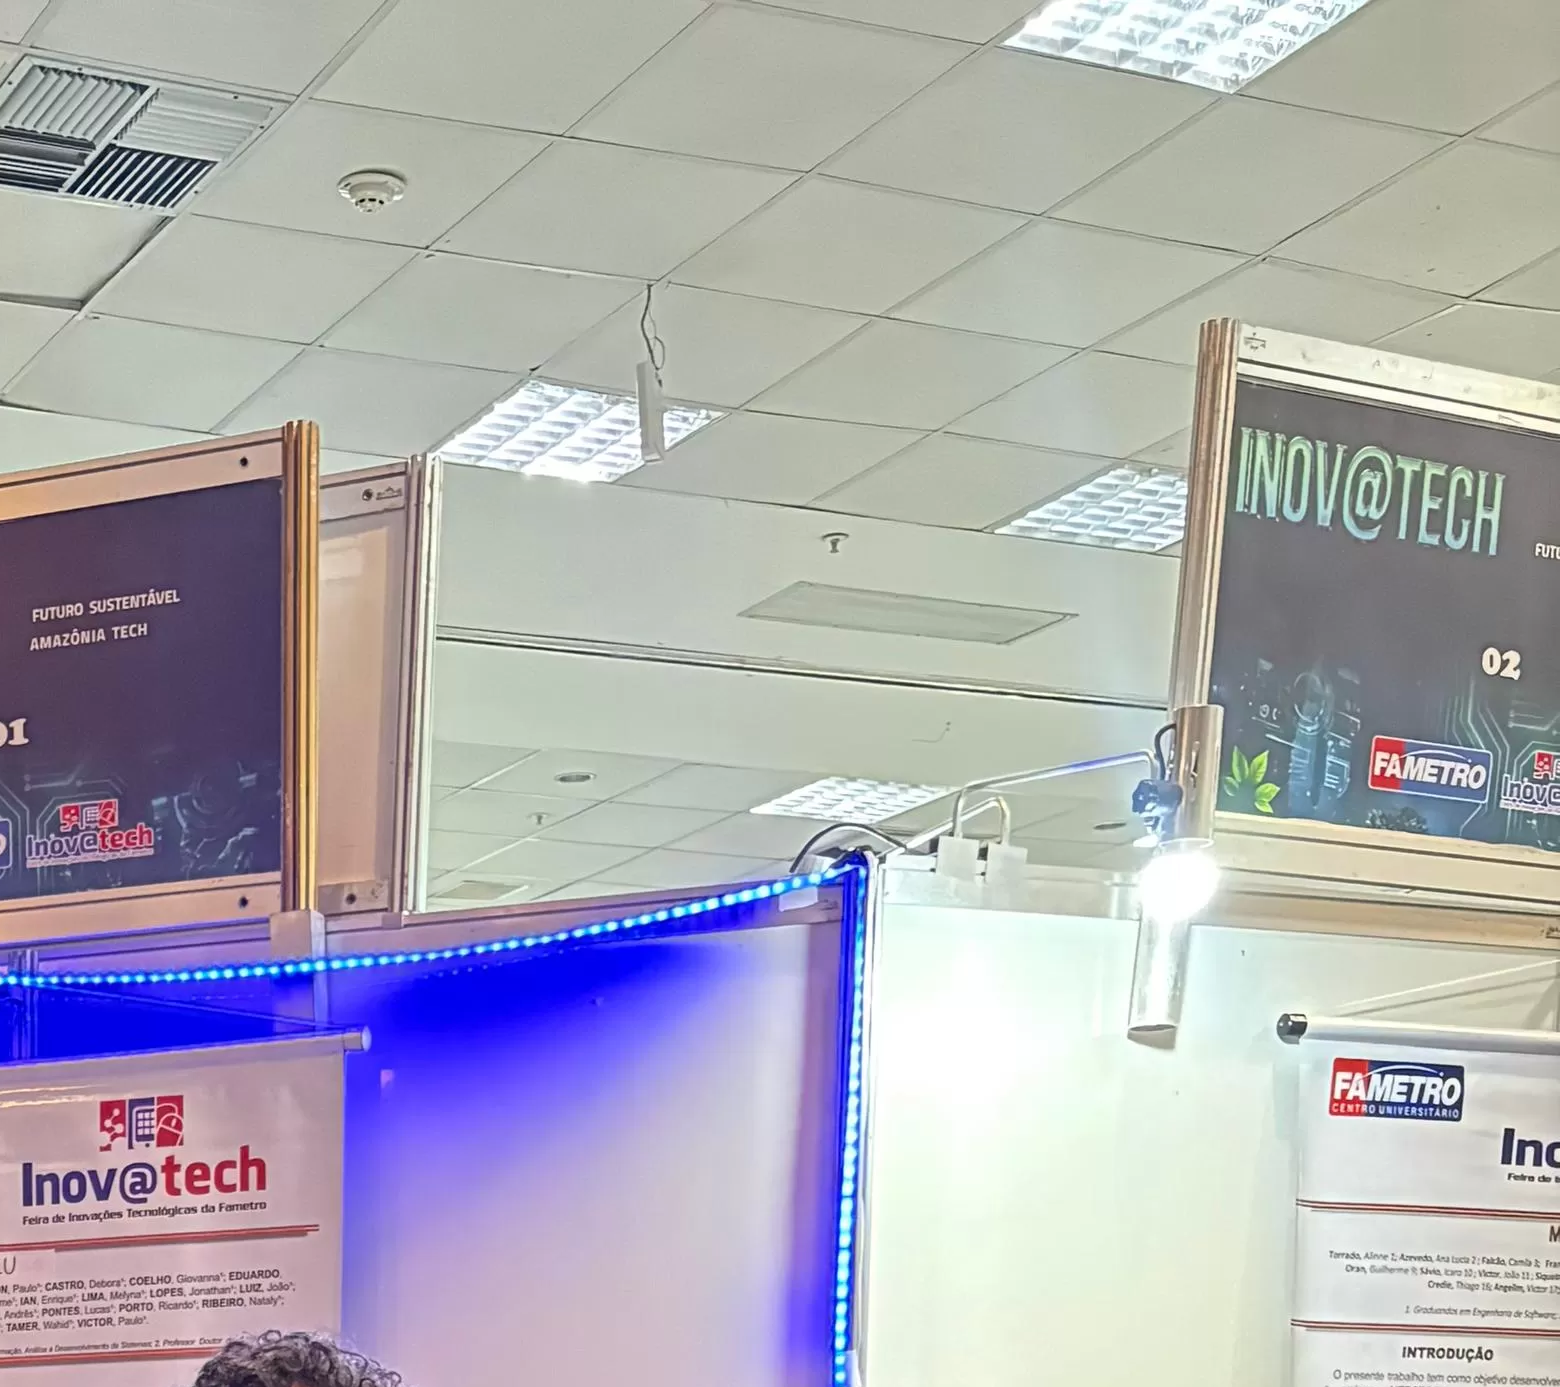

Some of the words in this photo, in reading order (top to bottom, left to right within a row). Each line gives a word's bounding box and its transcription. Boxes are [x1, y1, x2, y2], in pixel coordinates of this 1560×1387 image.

[1235, 427, 1506, 556] INOV@TECH
[32, 602, 83, 623] FUTURO
[89, 588, 180, 615] SUSTENTÁVEL
[30, 626, 106, 651] AMAZÔNIA
[112, 622, 148, 640] TECH
[1481, 647, 1521, 681] 02
[1374, 751, 1486, 789] FAMETRO
[26, 822, 154, 858] Inov@tech
[1334, 1072, 1461, 1106] FAMETRO
[1332, 1102, 1375, 1114] CENTRO
[22, 1145, 266, 1206] Inov@tech
[22, 1216, 48, 1225] Feira
[52, 1215, 65, 1223] de
[69, 1210, 122, 1222] Inovações
[127, 1205, 197, 1219] Tecnológicas
[201, 1204, 215, 1213] da
[218, 1201, 266, 1212] Fametro
[1402, 1346, 1494, 1362] INTRODUÇÃO
